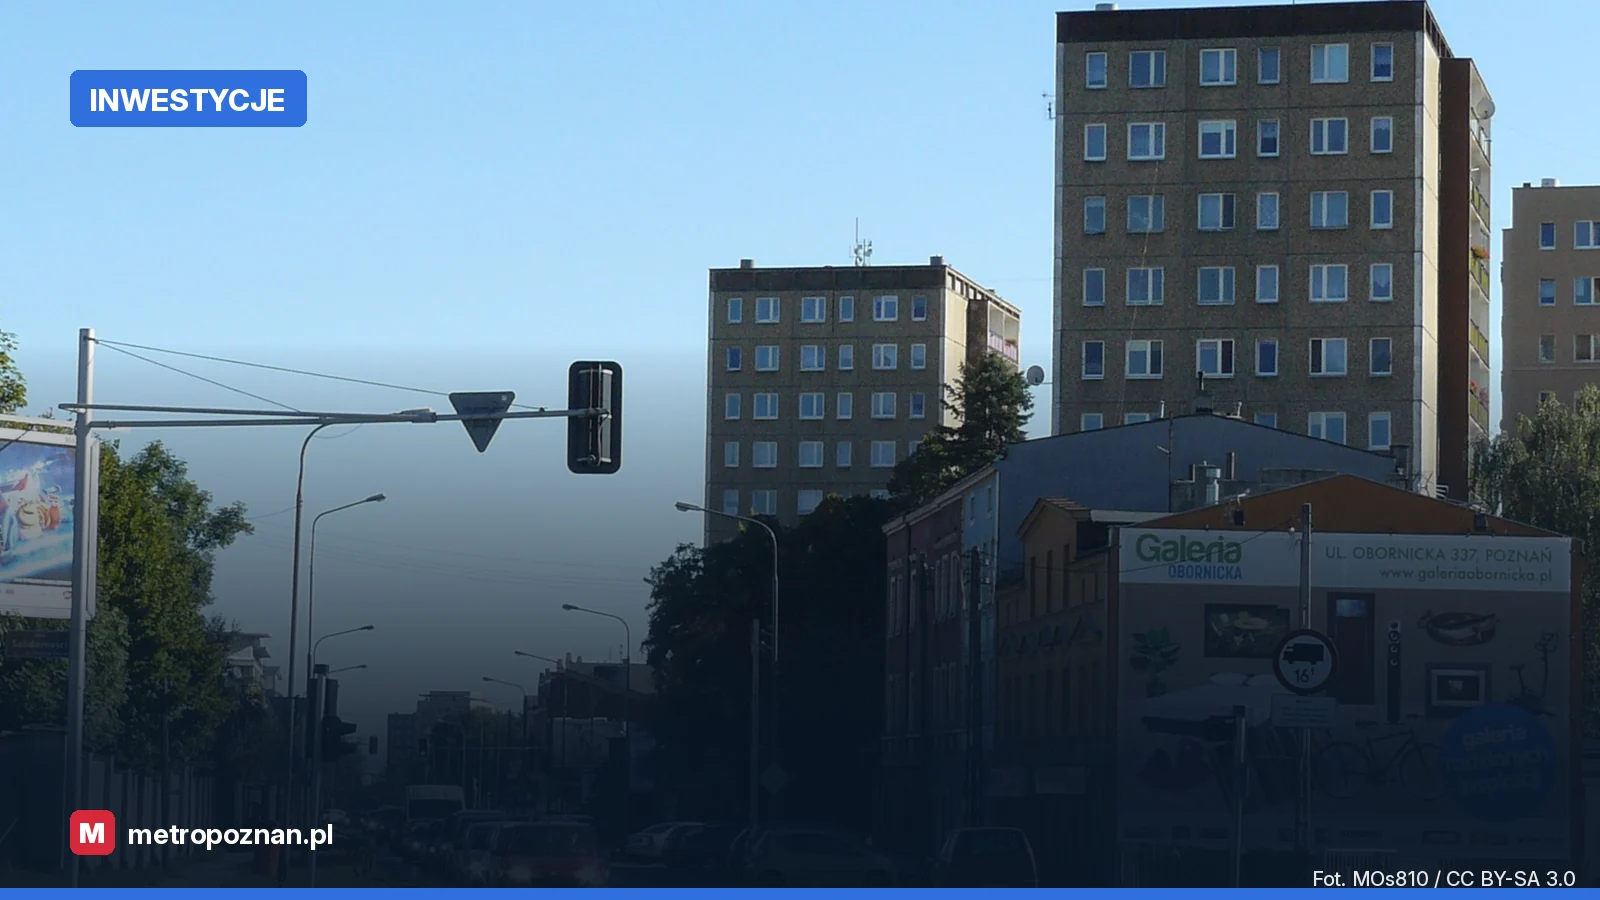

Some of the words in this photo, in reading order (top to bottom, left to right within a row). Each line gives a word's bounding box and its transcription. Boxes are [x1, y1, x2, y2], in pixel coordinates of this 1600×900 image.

[1135, 533, 1243, 564] Galeria
[1326, 547, 1347, 560] UL.
[1353, 547, 1446, 562] OBORNICKA
[1451, 549, 1480, 564] 337,
[1486, 547, 1553, 563] POZNAŃ
[1168, 565, 1243, 580] OBORNICKA
[1379, 566, 1553, 585] www.galeriaobornicka.pl
